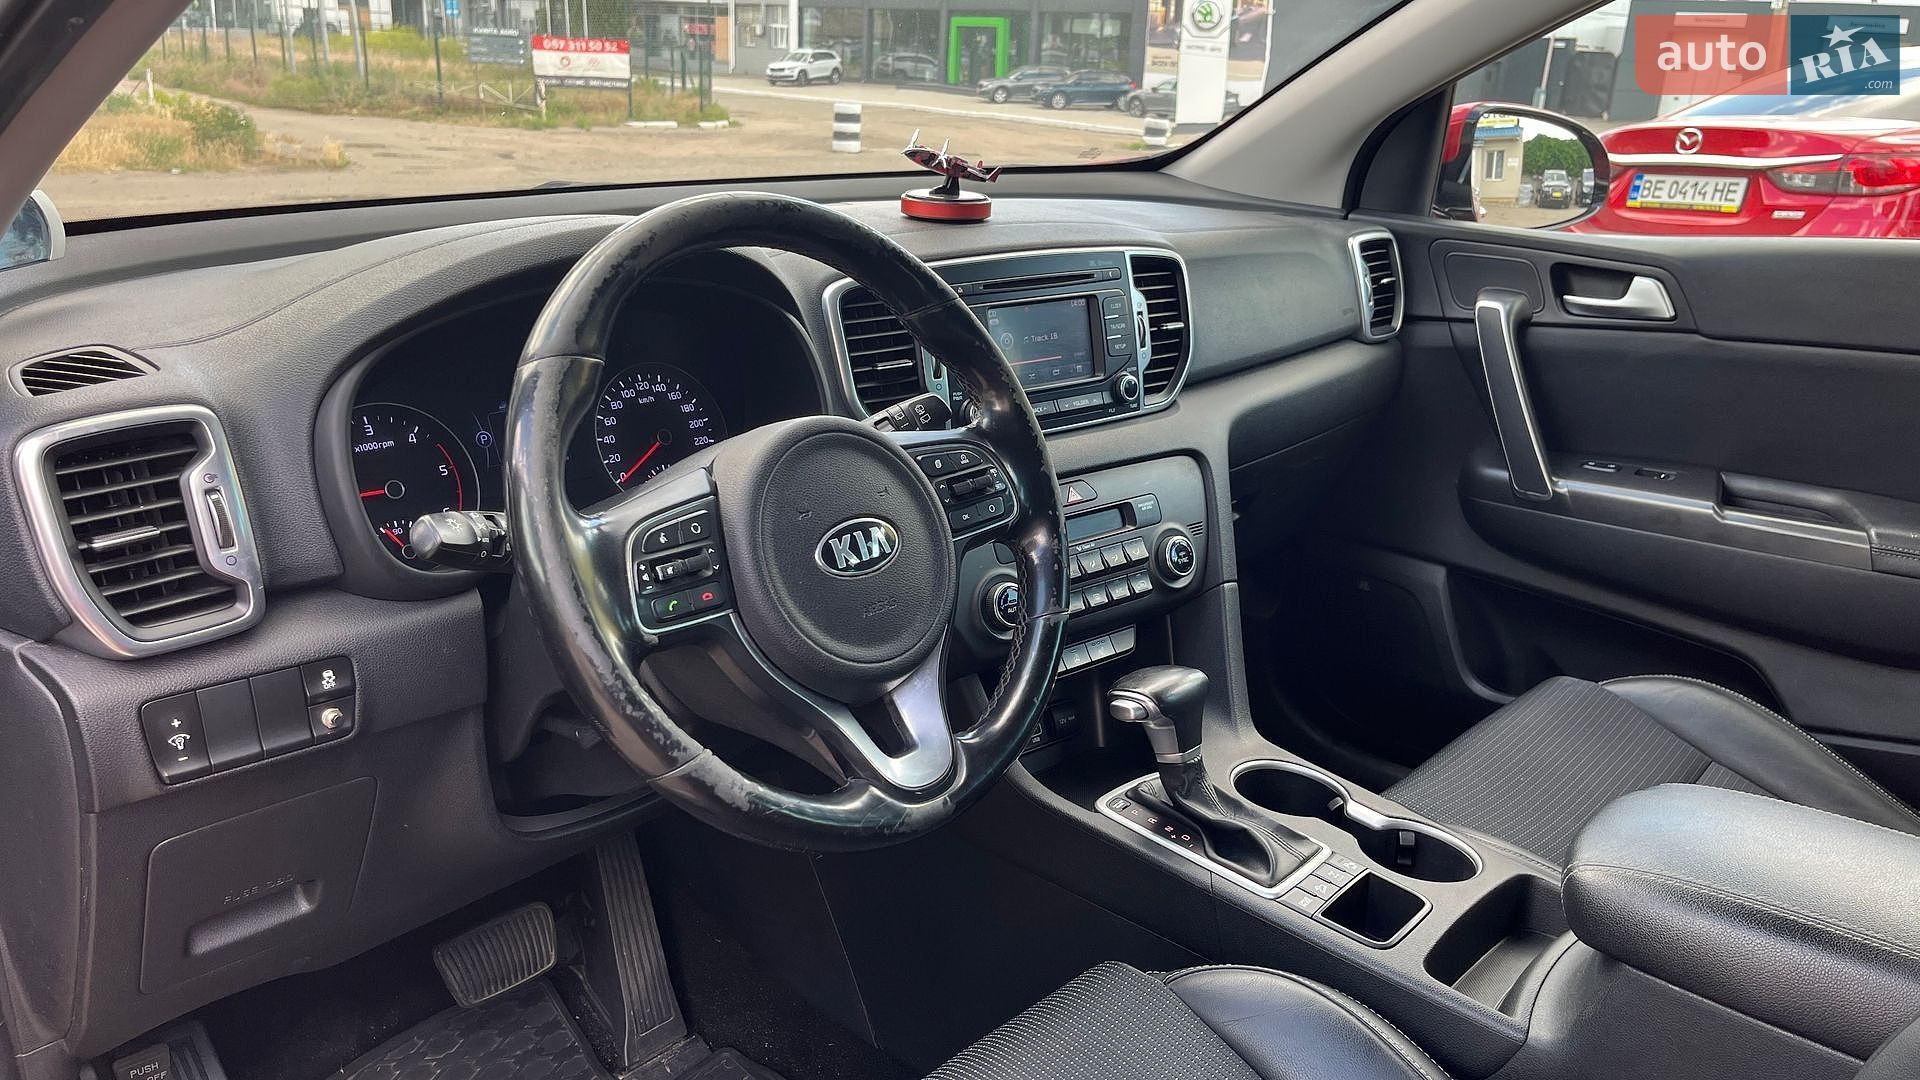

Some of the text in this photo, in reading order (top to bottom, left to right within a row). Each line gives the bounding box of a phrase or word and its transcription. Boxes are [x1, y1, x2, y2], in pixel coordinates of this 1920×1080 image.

[1640, 179, 1741, 202] BE 0414 HE
[1030, 334, 1050, 343] Track
[635, 381, 650, 391] 120
[651, 383, 667, 393] 140
[620, 388, 636, 399] 100
[667, 391, 682, 401] 160
[610, 400, 624, 411] 80
[638, 395, 656, 405] km/h
[680, 403, 695, 413] 180
[604, 416, 617, 427] 60
[689, 419, 704, 429] 200
[364, 424, 374, 436] 3
[408, 433, 417, 444] 4
[603, 434, 616, 445] 40
[694, 435, 709, 446] 220
[608, 453, 621, 464] 20
[438, 464, 449, 476] 5
[828, 526, 892, 569] KIA
[323, 681, 337, 690] OFF
[129, 1061, 160, 1079] PUSH
